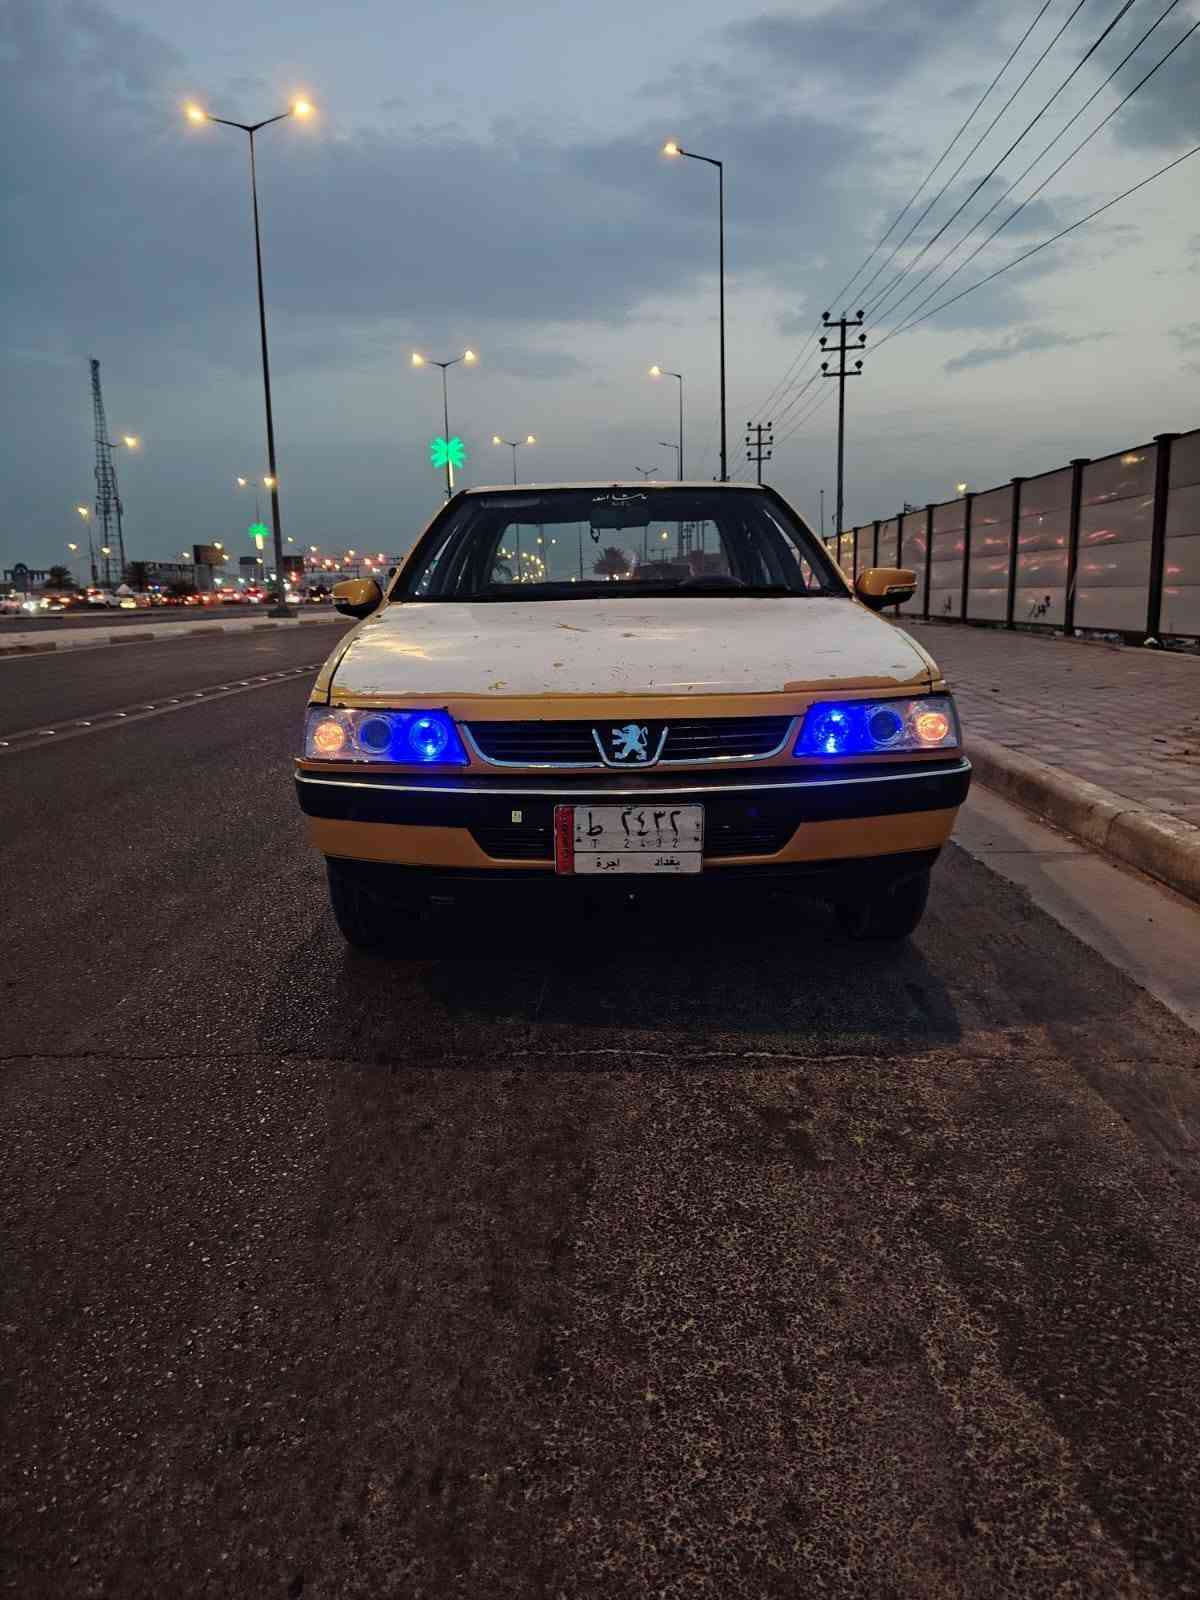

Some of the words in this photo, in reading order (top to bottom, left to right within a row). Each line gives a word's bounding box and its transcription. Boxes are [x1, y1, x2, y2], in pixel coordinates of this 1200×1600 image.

[586, 811, 604, 837] ط
[621, 810, 682, 837] ٢٤٣٢
[654, 856, 681, 871] بغداد
